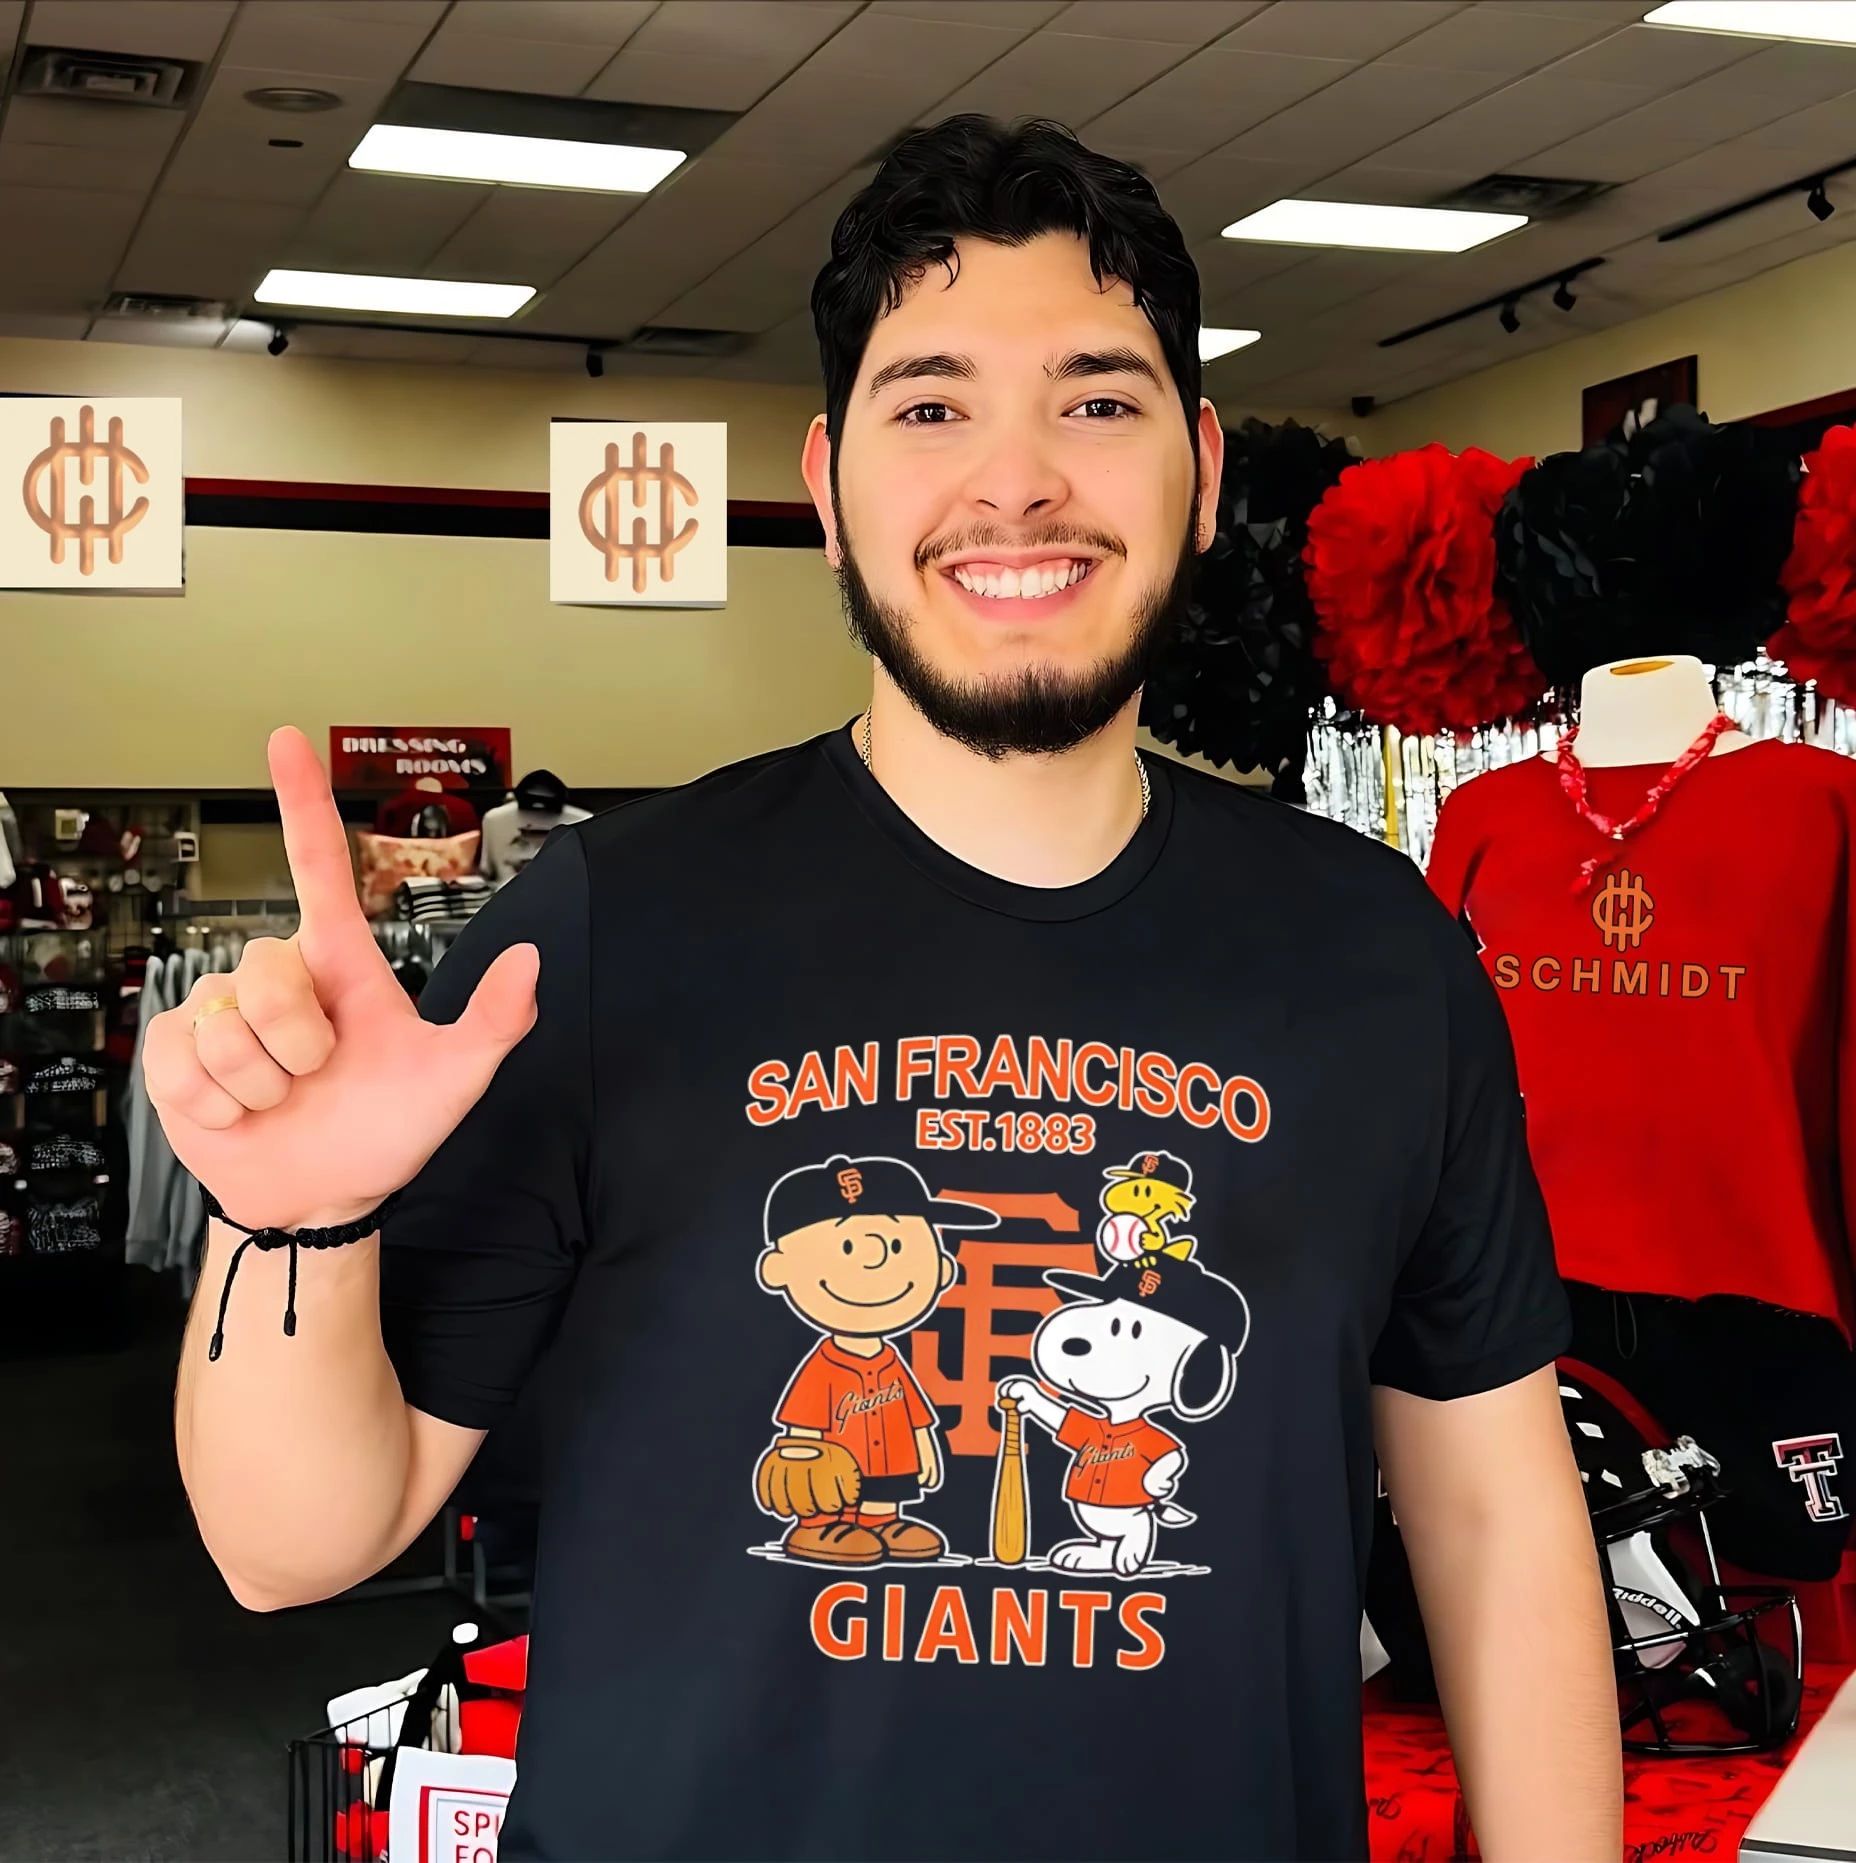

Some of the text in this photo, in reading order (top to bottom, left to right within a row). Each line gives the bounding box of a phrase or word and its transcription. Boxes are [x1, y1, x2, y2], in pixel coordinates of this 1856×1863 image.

[342, 737, 467, 754] DRESSING
[396, 758, 487, 775] ROOMS
[1494, 954, 1747, 1000] SCHMIDT
[746, 1034, 1271, 1142] SAN FRANCISCO
[915, 1109, 1097, 1154] EST.1883
[836, 1377, 905, 1435] Giants
[1077, 1442, 1136, 1478] Giants
[810, 1581, 1167, 1671] GIANTS
